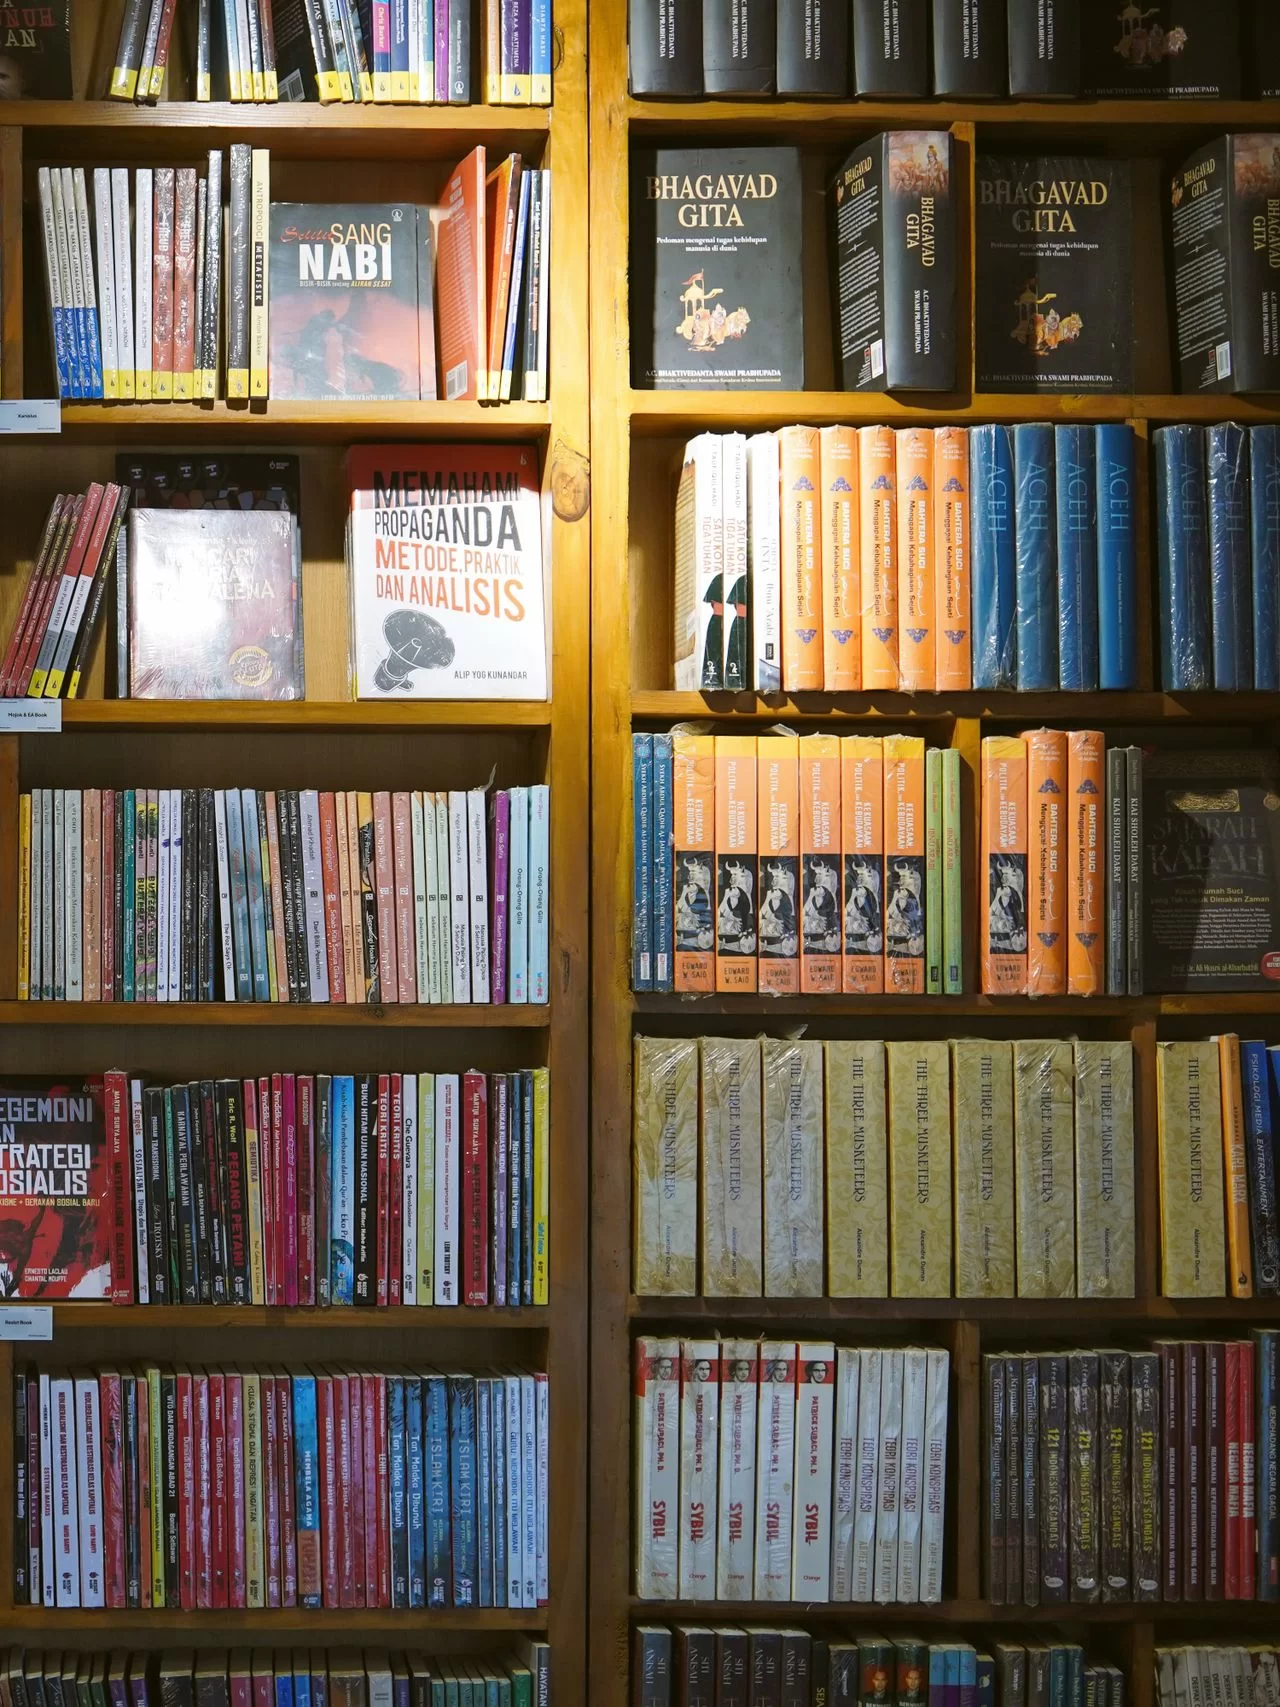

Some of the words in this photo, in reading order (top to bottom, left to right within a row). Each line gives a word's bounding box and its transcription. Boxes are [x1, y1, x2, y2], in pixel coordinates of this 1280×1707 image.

[646, 174, 777, 200] BHAGAVAD
[980, 181, 1108, 205] BHAGAVAD
[678, 204, 744, 227] GITA
[906, 213, 920, 249] GITA
[921, 196, 935, 267] BHAGAVAD
[1012, 209, 1076, 233] GITA
[330, 223, 391, 246] SANG
[686, 237, 715, 245] mengenai
[734, 236, 767, 244] kehidupan
[299, 244, 392, 280] NABI
[374, 471, 520, 508] MEMAHAMI
[988, 462, 1007, 531] ACEH
[1110, 462, 1129, 531] ACEH
[375, 504, 522, 551] PROPAGANDA
[376, 539, 463, 574] METODE,
[376, 574, 404, 602] DAN
[410, 575, 525, 622] ANALISIS
[455, 671, 469, 679] ALIP
[472, 671, 486, 679] YOG
[488, 671, 527, 679] KUNANDAR
[728, 761, 736, 789] POLITIK
[728, 798, 737, 848] KEBUDAYAAN
[724, 967, 749, 976] EDWARD
[852, 1057, 863, 1080] THE
[1188, 1057, 1199, 1081] THE
[1251, 1054, 1261, 1099] PSIKOLOGI
[852, 1084, 864, 1122] THREE
[1188, 1085, 1200, 1122] THREE
[1254, 1103, 1263, 1135] MEDIA
[177, 1111, 185, 1151] KARNAVAL
[180, 1153, 190, 1206] PERLAWANAN
[229, 1151, 240, 1209] PERANG
[854, 1126, 865, 1203] MUSKETEERS
[1190, 1126, 1202, 1203] MUSKETEERS
[1255, 1139, 1268, 1216] ENTERTAINMENT
[57, 1198, 80, 1206] SOSIAL
[82, 1198, 100, 1206] BARU
[231, 1212, 243, 1267] PETANI
[863, 1438, 874, 1462] TEORI
[860, 1464, 874, 1513] KONSPIRASI
